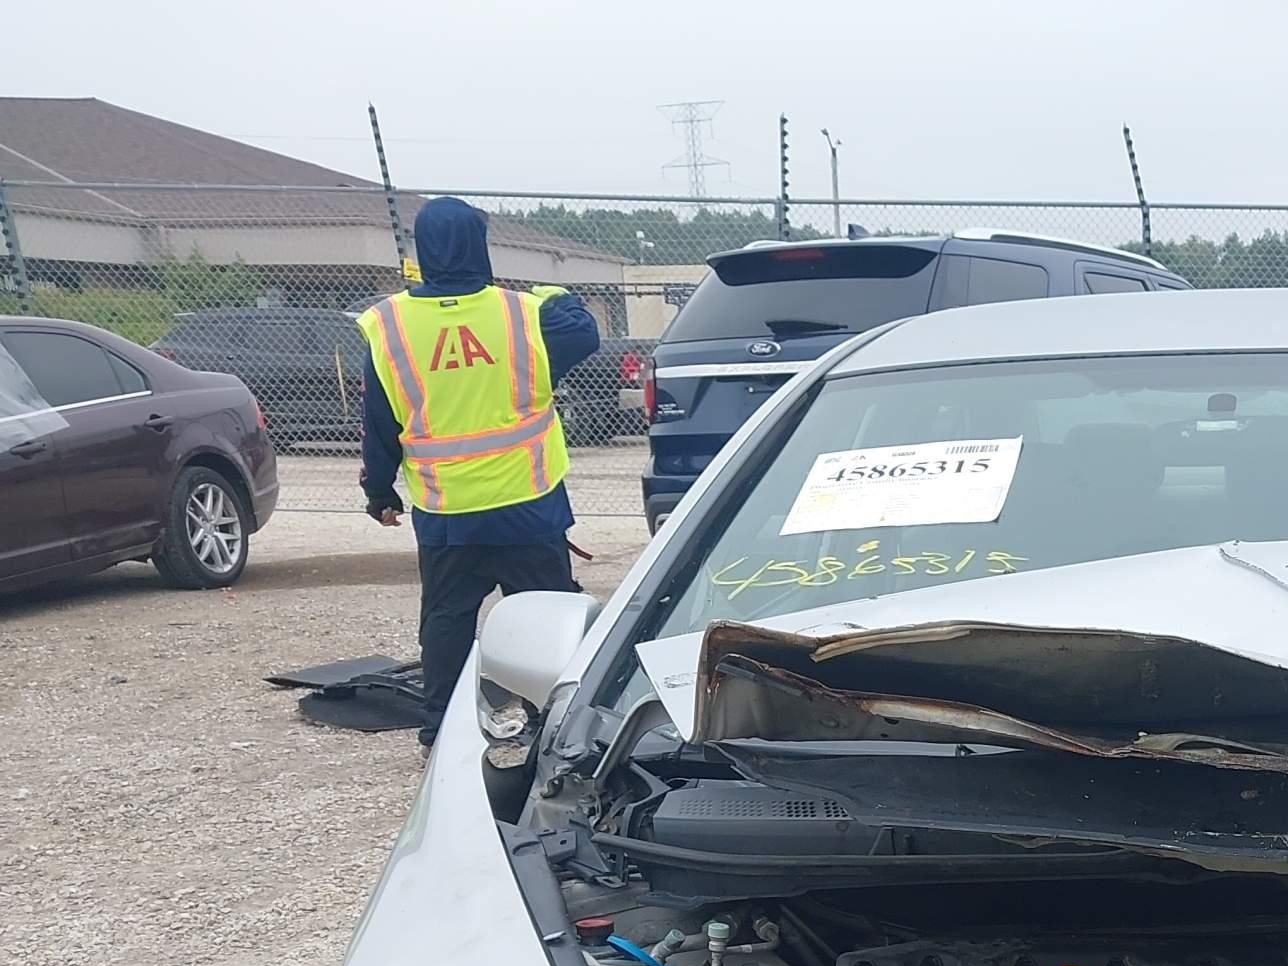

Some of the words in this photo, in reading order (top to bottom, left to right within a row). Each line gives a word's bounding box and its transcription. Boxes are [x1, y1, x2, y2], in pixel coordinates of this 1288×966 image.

[751, 342, 772, 353] Ford
[827, 458, 992, 482] 45865315
[712, 550, 1029, 600] 45865315
